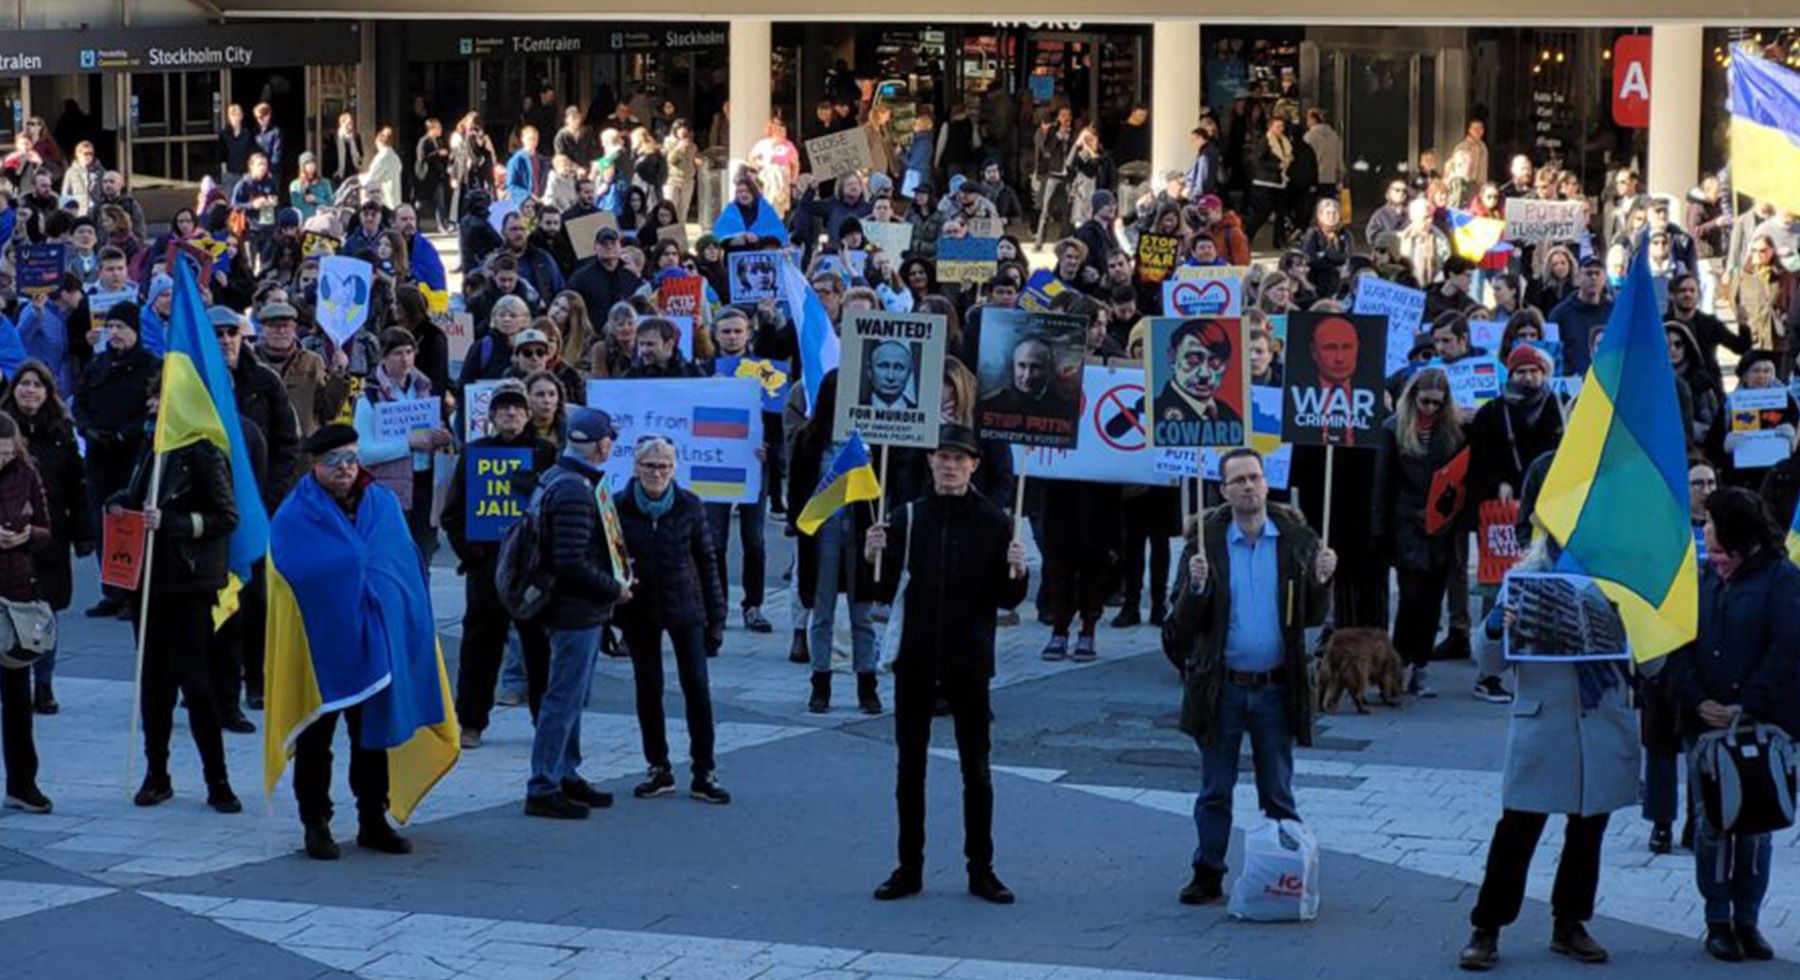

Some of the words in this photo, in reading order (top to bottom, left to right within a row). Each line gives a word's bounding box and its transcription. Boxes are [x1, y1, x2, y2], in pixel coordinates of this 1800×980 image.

[512, 36, 580, 52] T-Centralen
[666, 30, 725, 47] Stockholm
[149, 47, 222, 65] Stockholm
[225, 46, 252, 65] City
[1619, 61, 1649, 99] A
[810, 134, 848, 154] CLOSE
[1141, 234, 1178, 249] STOP
[1140, 254, 1174, 267] WAR
[855, 318, 932, 340] WANTED!
[1291, 385, 1375, 417] WAR
[643, 411, 689, 430] from
[849, 407, 871, 420] FOR
[874, 408, 925, 424] MURDER
[983, 411, 1023, 427] STOP
[1026, 415, 1073, 431] PUTIN
[1294, 413, 1371, 429] CRIMINAL
[1155, 420, 1242, 446] COWARD
[478, 459, 522, 476] PUT
[487, 480, 511, 496] IN
[476, 500, 523, 516] JAIL
